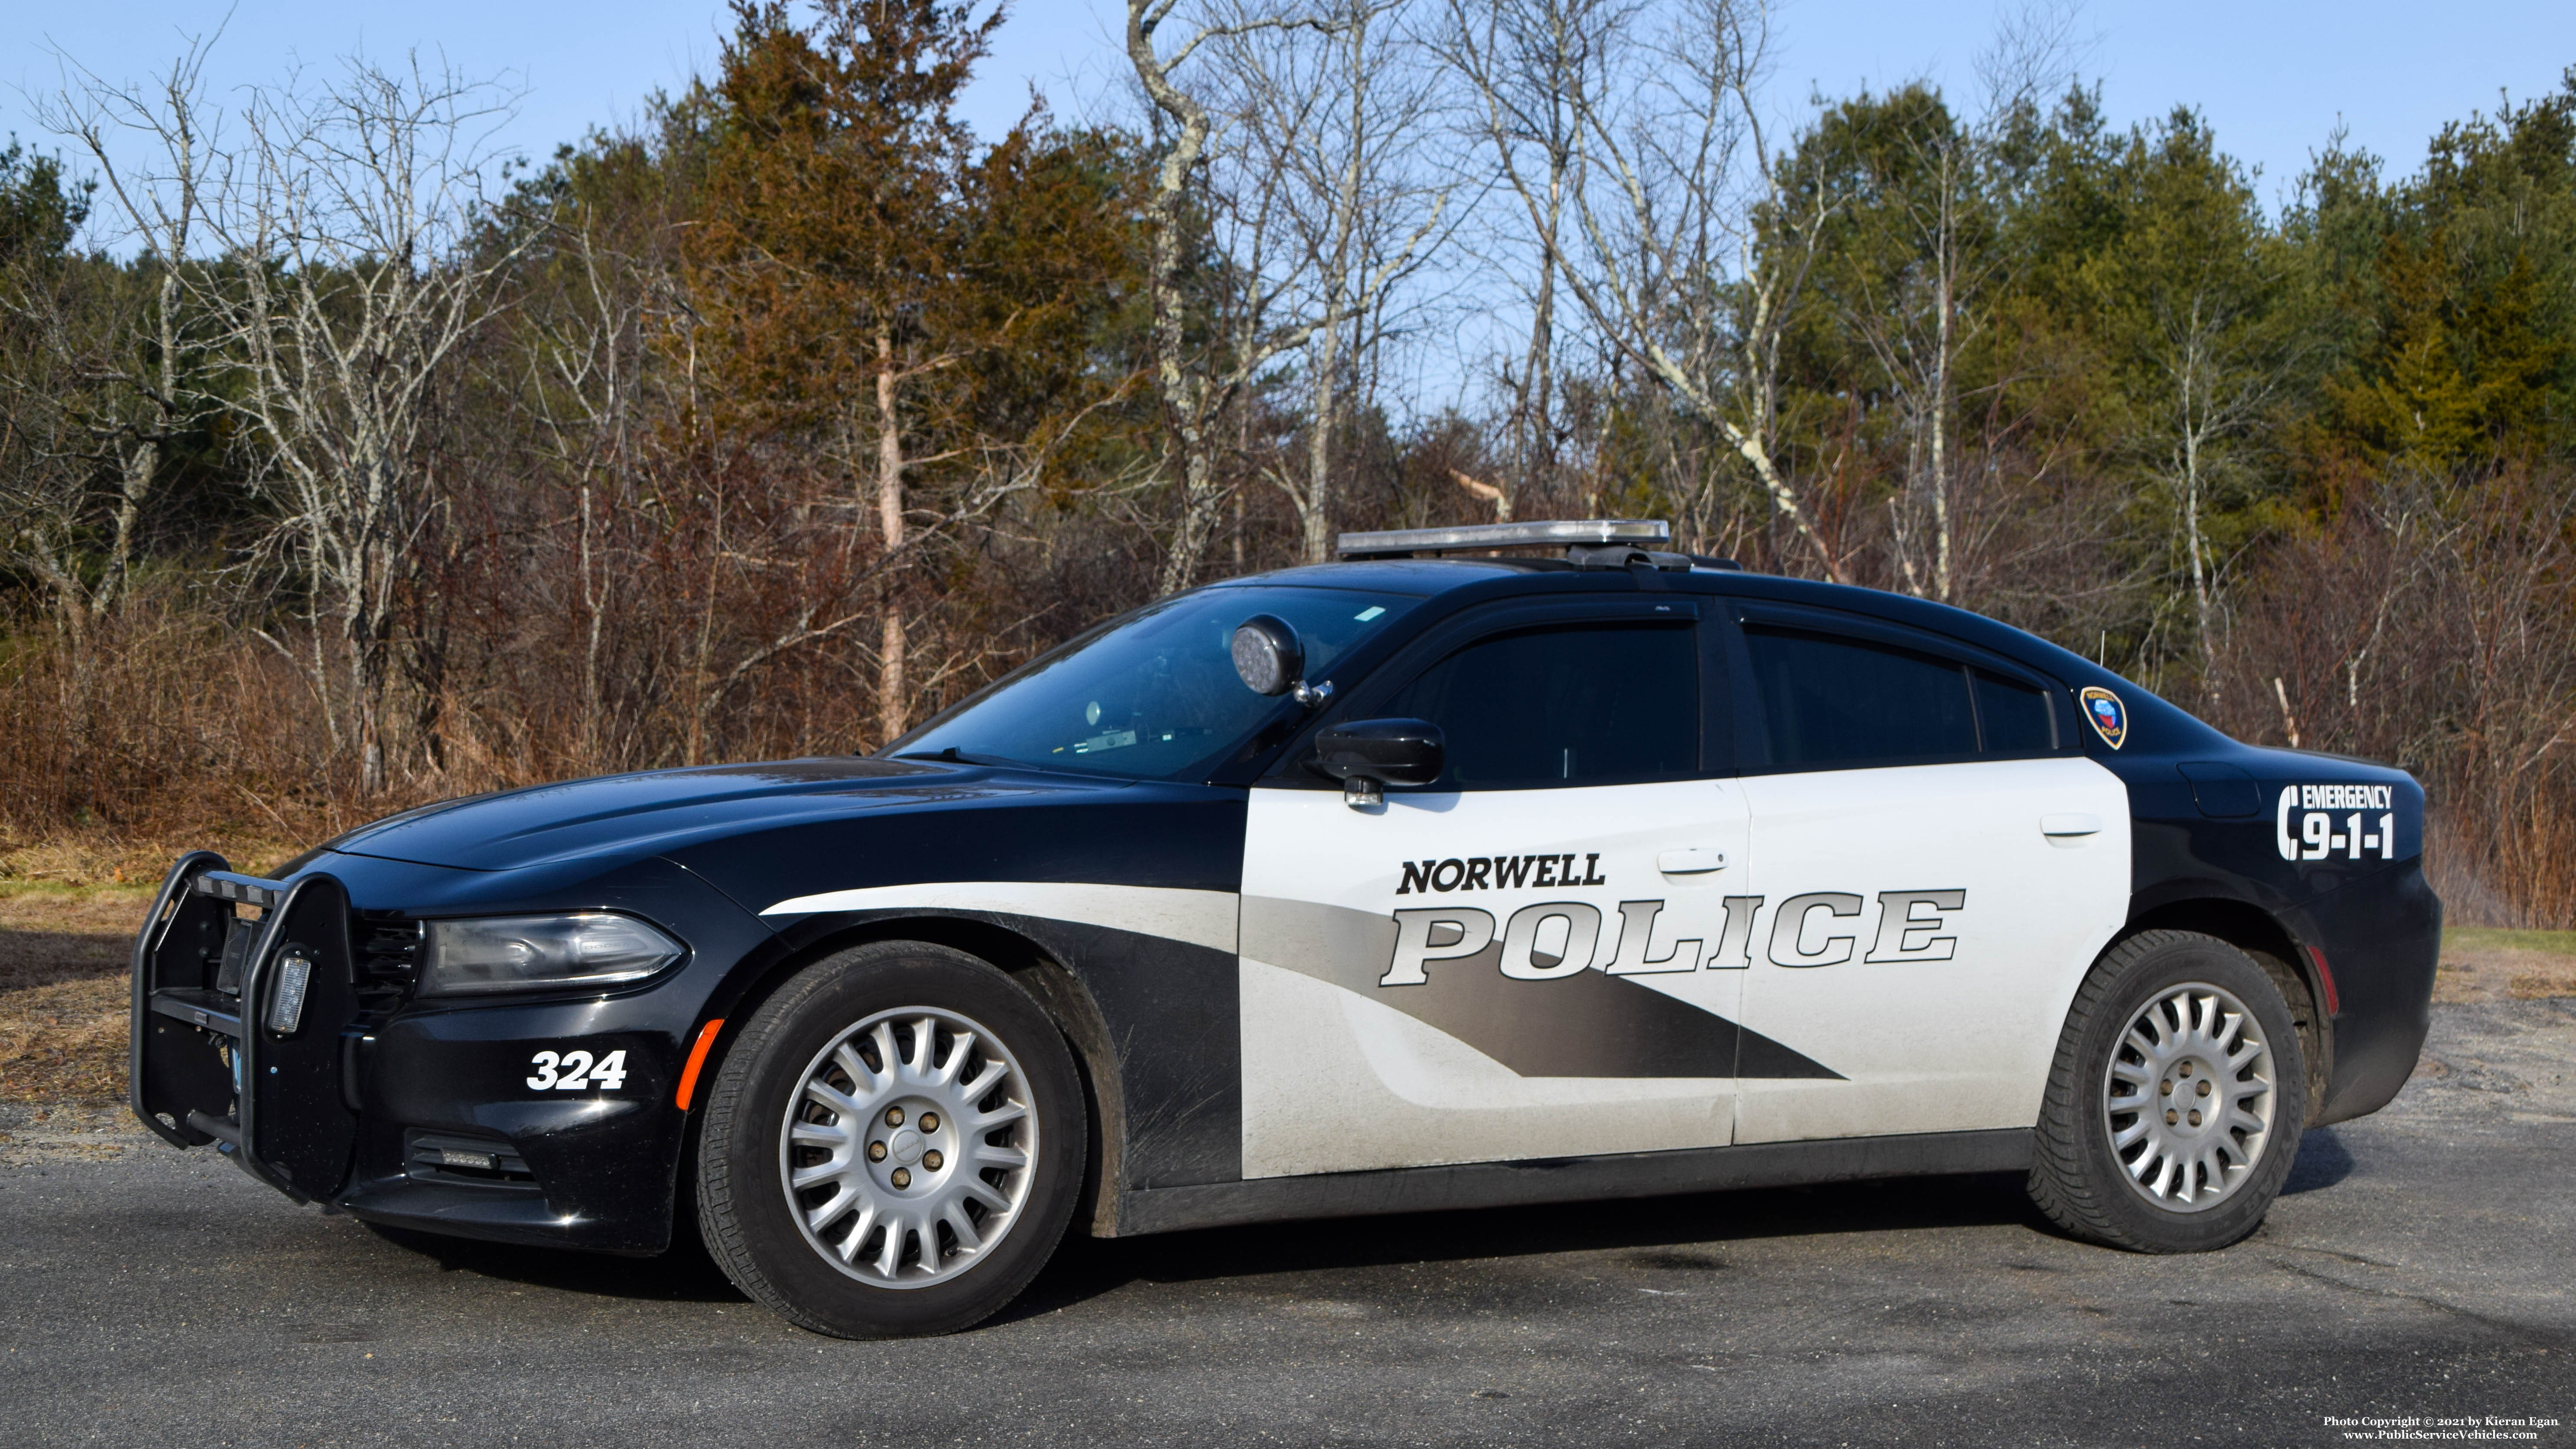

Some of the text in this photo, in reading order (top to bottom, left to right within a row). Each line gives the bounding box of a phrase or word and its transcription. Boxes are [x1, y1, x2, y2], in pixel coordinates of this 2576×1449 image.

[2101, 726, 2121, 736] POLICE
[2302, 785, 2392, 810] EMERGENCY
[2302, 812, 2393, 860] 9-1-1
[1395, 853, 1606, 895] NORWELL
[1378, 888, 1967, 988] POLICE
[527, 1050, 627, 1090] 324
